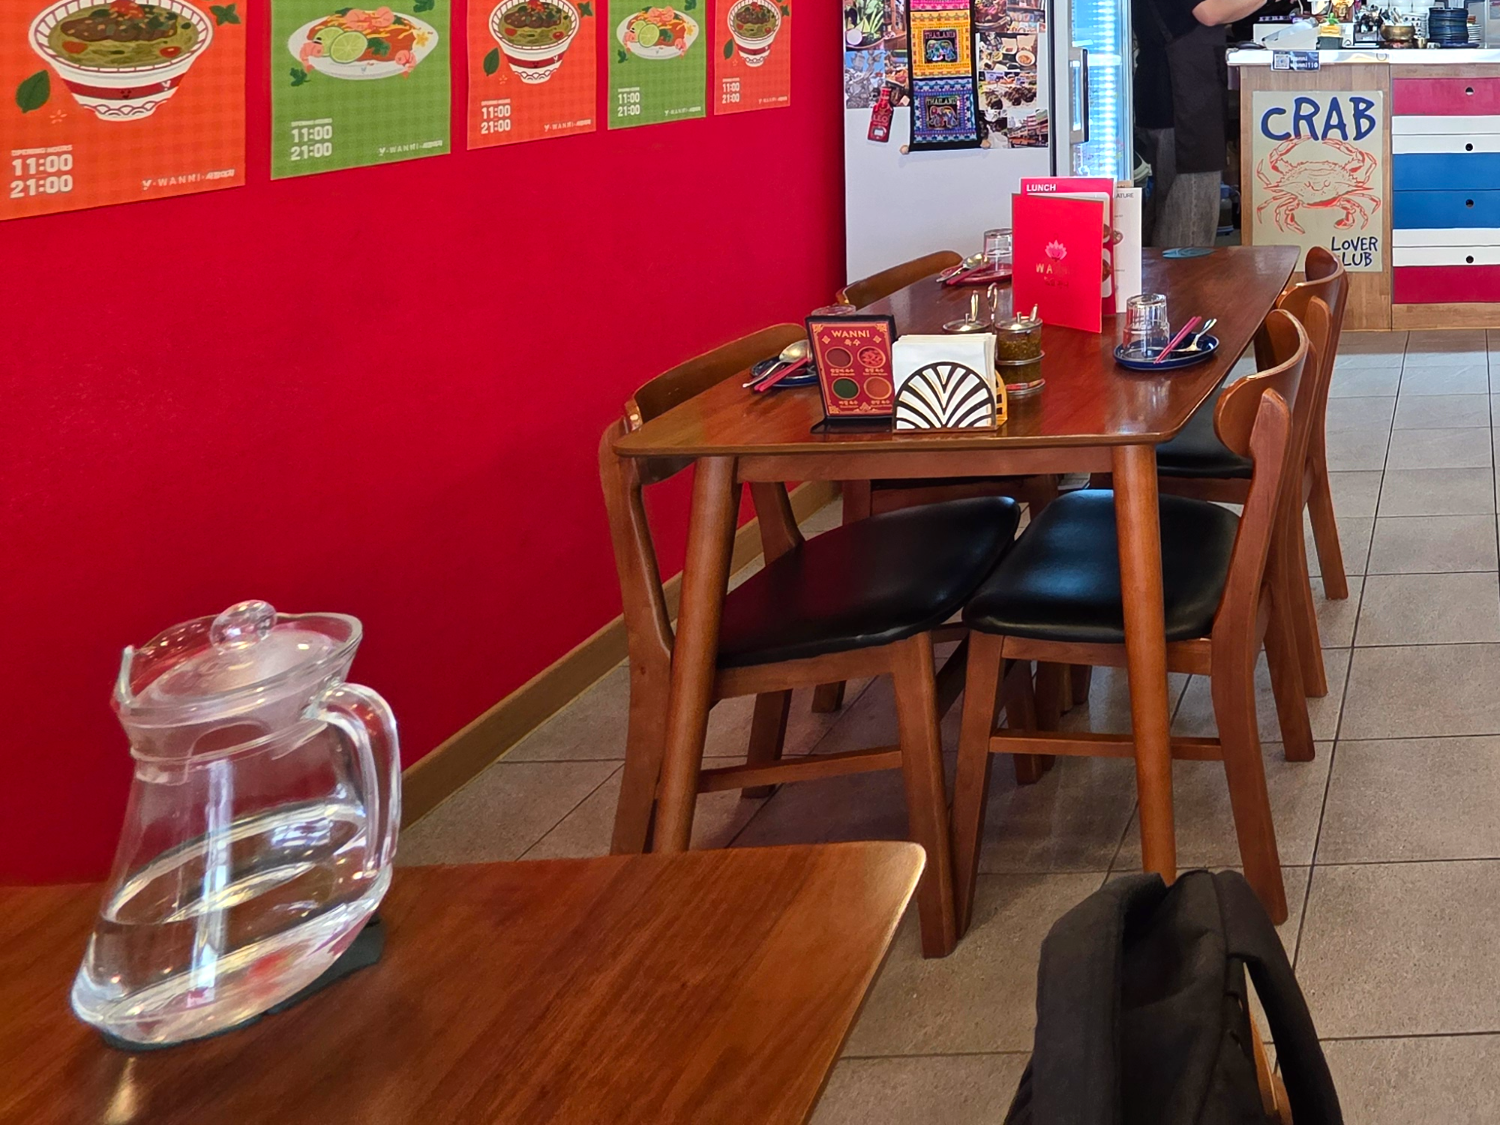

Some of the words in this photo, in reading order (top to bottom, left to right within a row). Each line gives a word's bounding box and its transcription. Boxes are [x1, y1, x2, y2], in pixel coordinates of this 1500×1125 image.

[722, 81, 741, 93] 11:00
[617, 92, 641, 105] 11:00
[722, 93, 741, 104] 21:00
[481, 104, 511, 120] 11:00
[617, 104, 641, 117] 21:00
[1261, 96, 1376, 141] CRAB
[291, 125, 333, 143] 11:00
[480, 118, 511, 134] 21:00
[290, 142, 333, 161] 21:00
[12, 154, 73, 177] 11:00
[10, 175, 73, 199] 21:00
[1026, 183, 1057, 192] LUNCH
[1331, 236, 1379, 252] LOVER
[1341, 251, 1373, 267] LUB
[831, 330, 870, 338] WANNI
